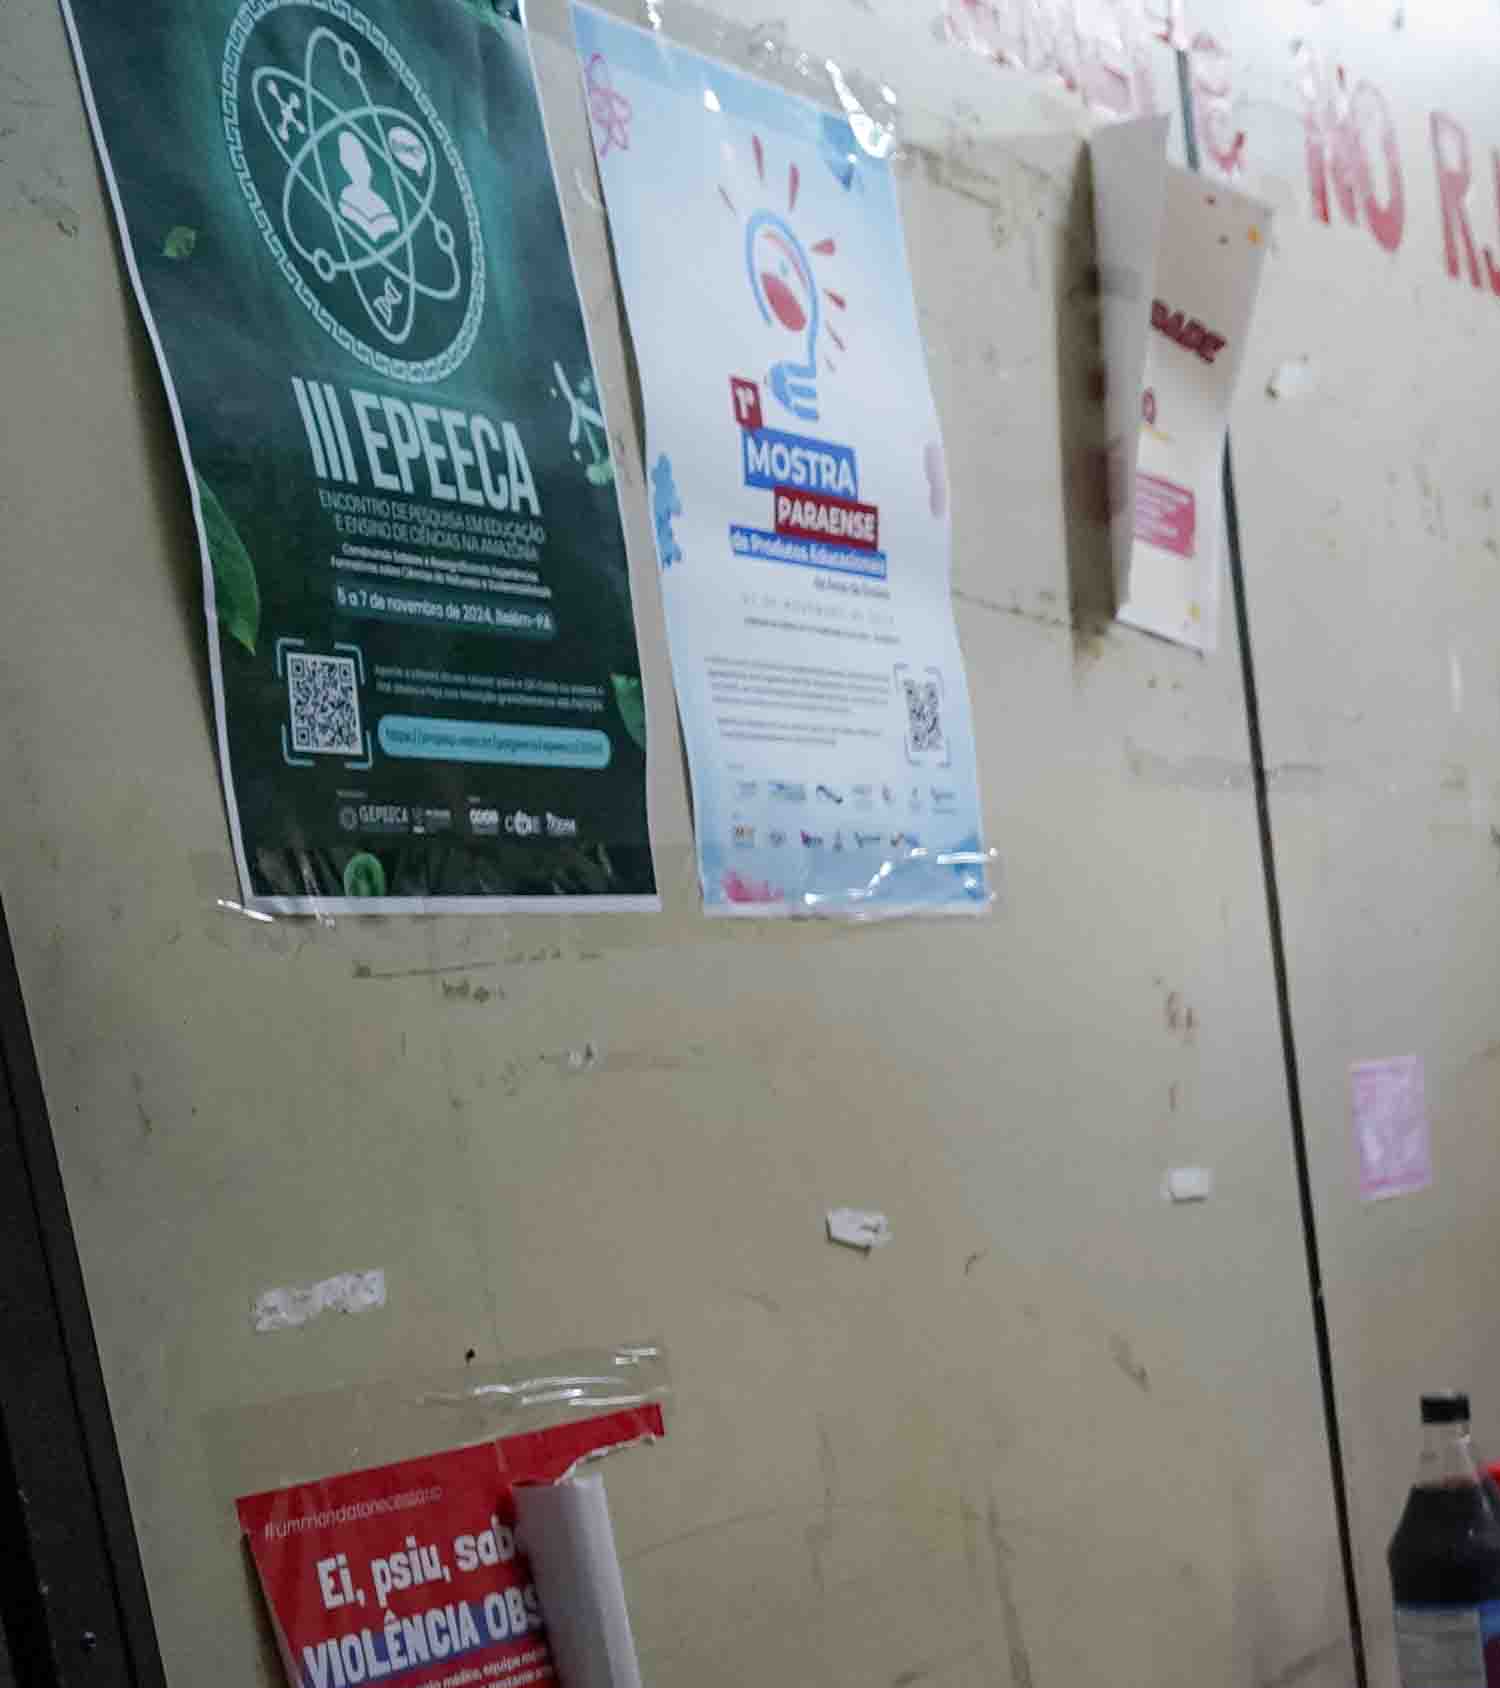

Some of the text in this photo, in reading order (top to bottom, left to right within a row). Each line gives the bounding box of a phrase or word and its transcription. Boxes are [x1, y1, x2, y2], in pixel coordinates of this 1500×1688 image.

[292, 376, 542, 516] III EPEECA
[746, 436, 856, 494] MOSTRA
[777, 495, 876, 542] PARAENSE
[315, 1535, 453, 1611] Ei, psiu,
